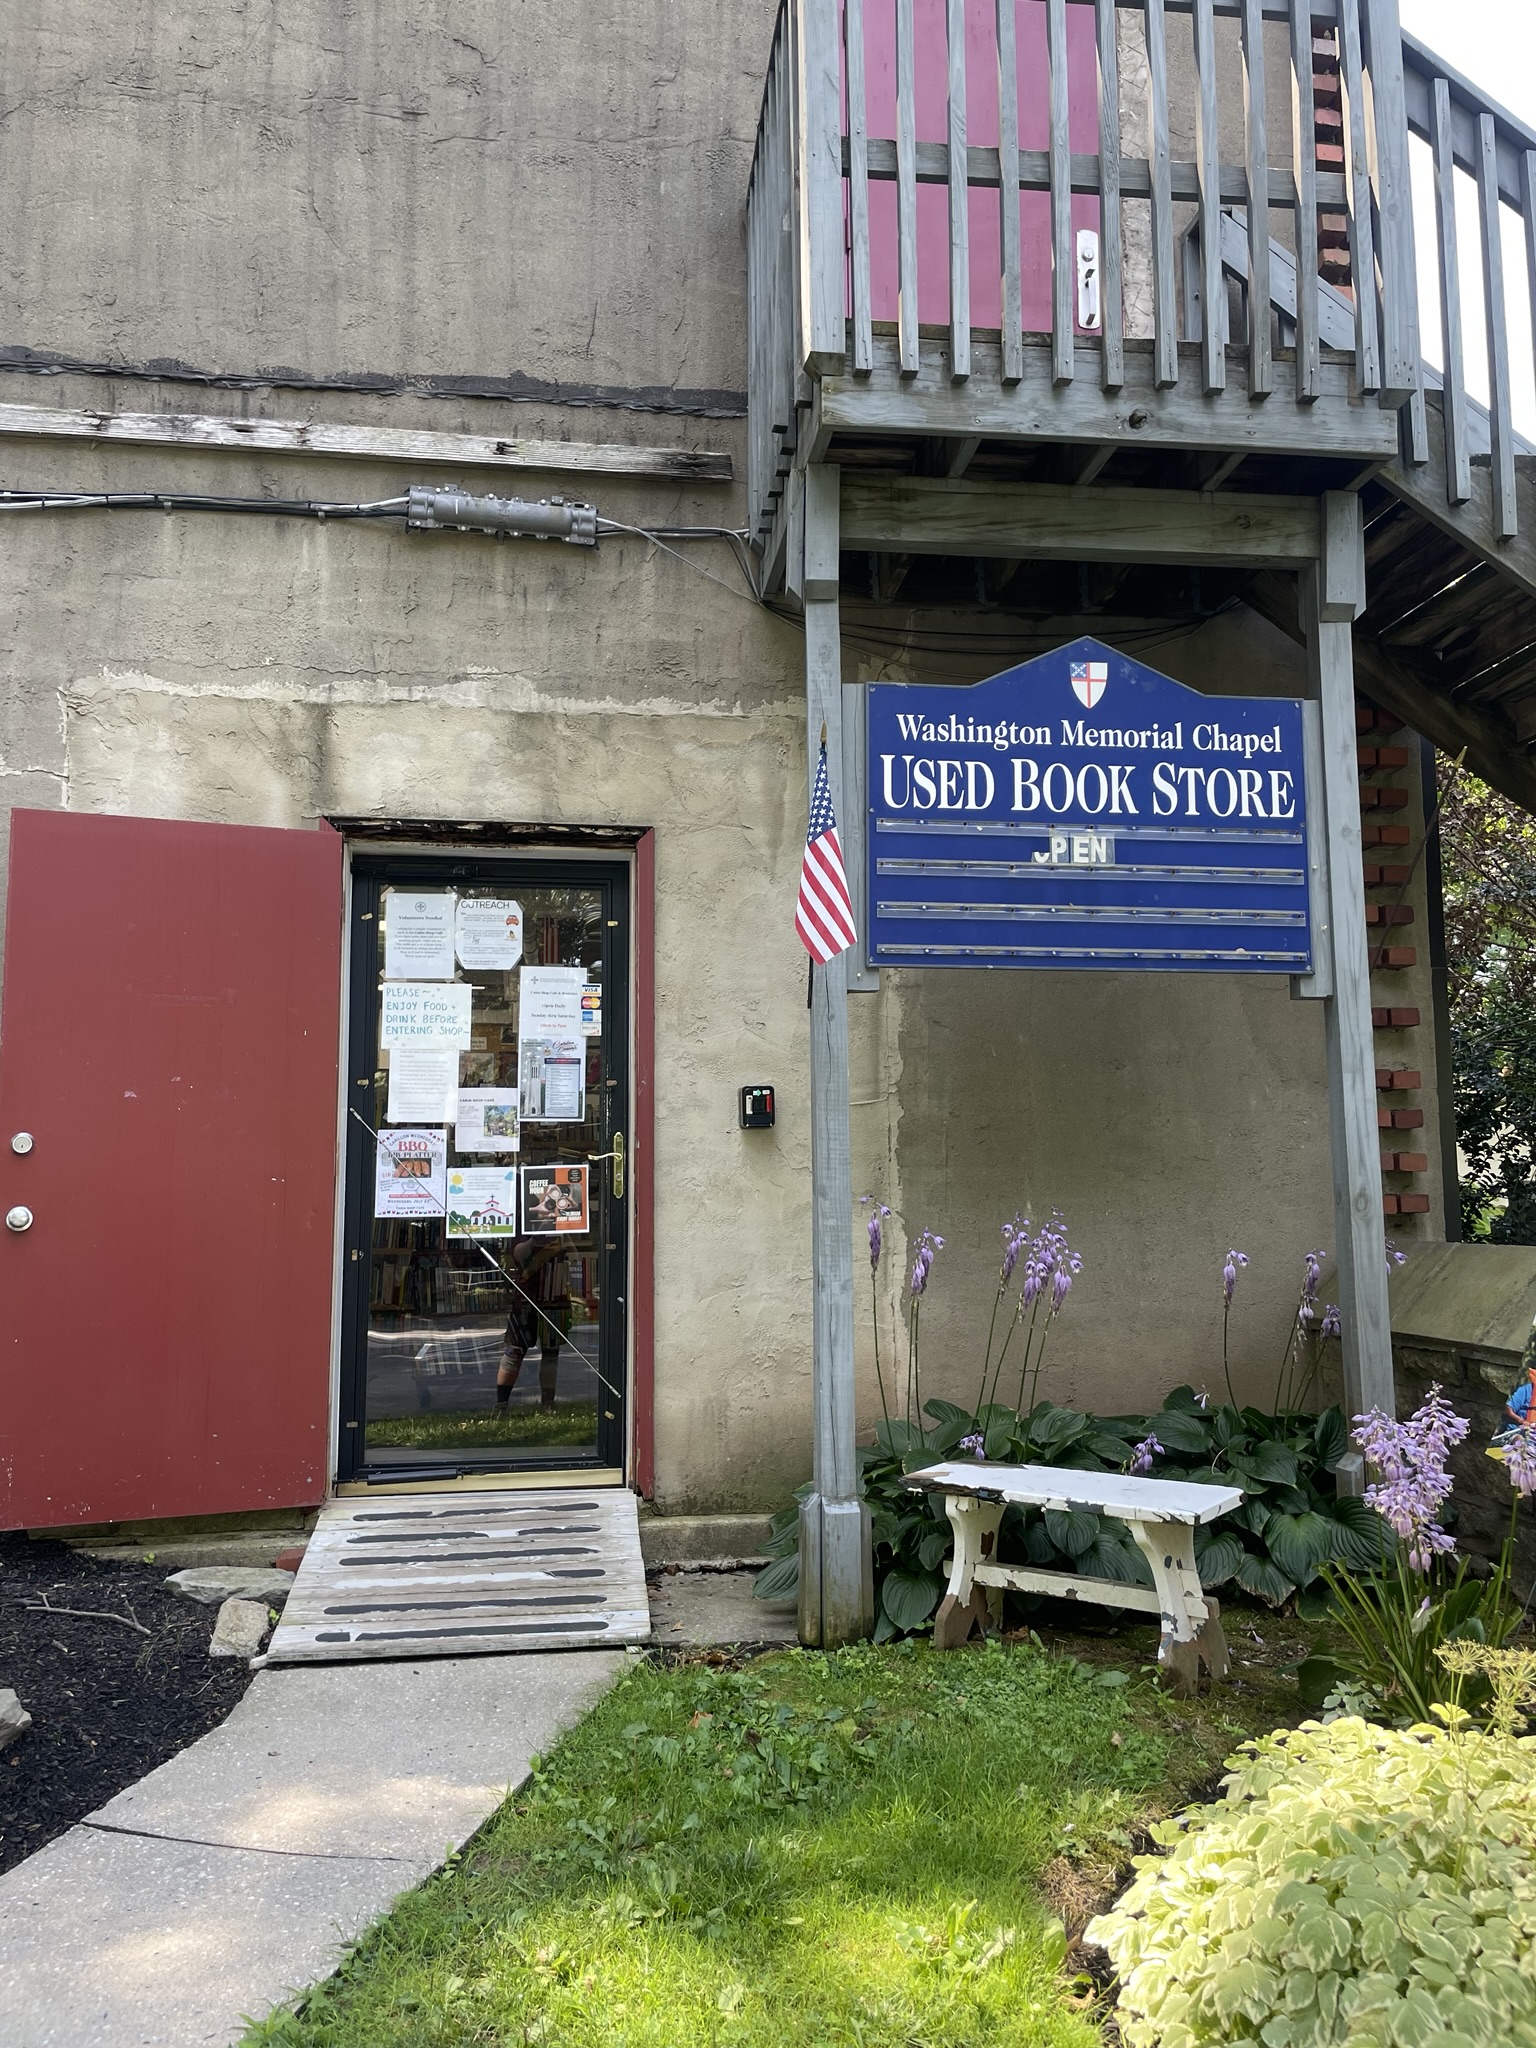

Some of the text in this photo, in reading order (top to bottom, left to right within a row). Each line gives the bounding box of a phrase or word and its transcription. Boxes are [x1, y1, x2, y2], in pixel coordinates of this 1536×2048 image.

[896, 713, 1282, 759] Washington Memorial Chapel
[880, 754, 1296, 818] USED BOOK STORE
[460, 900, 510, 909] OUTREACH
[386, 987, 420, 997] PLEASE
[386, 1002, 418, 1011] ENJOY
[423, 1001, 448, 1011] FOOD
[386, 1014, 458, 1024] DRINK BEFORE
[385, 1026, 433, 1035] ENTERING
[398, 1141, 428, 1151] BBQ
[529, 1179, 549, 1187] COFFEE
[529, 1186, 545, 1194] HOUR
